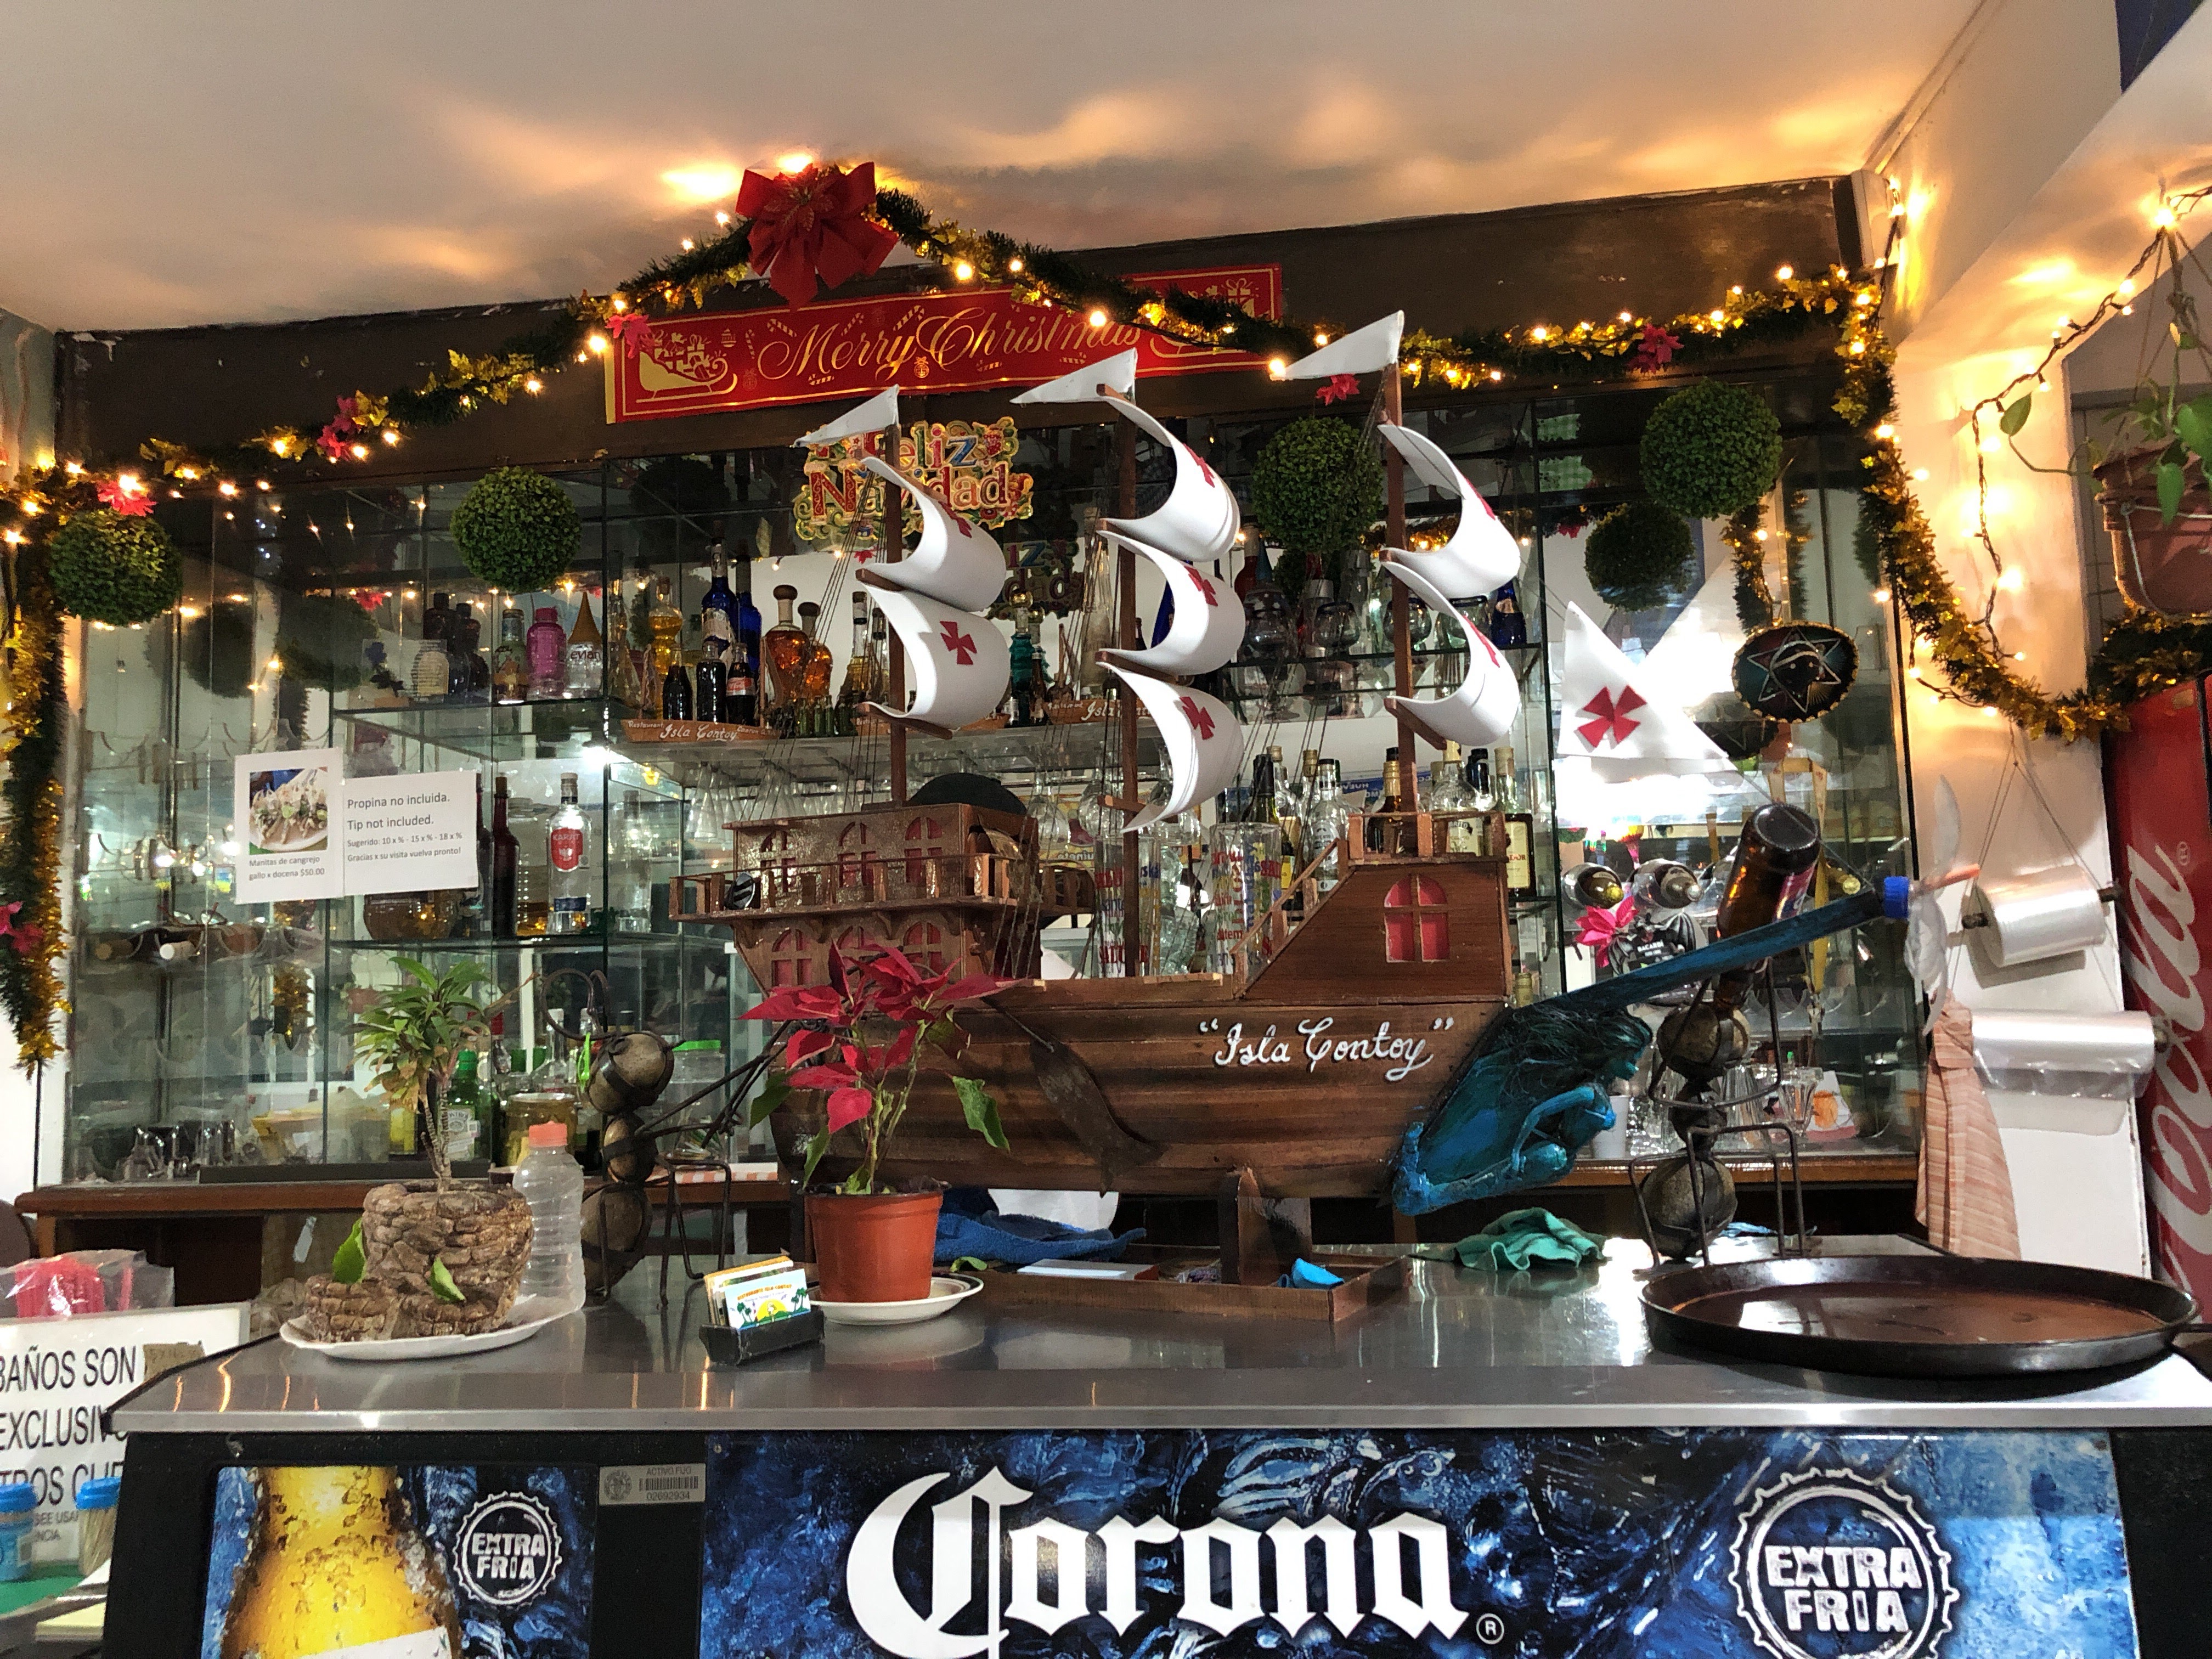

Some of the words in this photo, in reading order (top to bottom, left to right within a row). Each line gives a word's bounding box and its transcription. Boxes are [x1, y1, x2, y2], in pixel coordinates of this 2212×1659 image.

[758, 324, 917, 381] Merry
[916, 307, 1141, 371] Christmas
[660, 724, 690, 739] Isla
[697, 724, 737, 741] Contoy
[347, 797, 387, 810] Propina
[391, 798, 404, 806] no
[407, 792, 450, 805] incluida.
[348, 820, 363, 831] Tip
[366, 819, 383, 828] not
[387, 814, 434, 827] included.
[347, 838, 380, 848] Sugerido:
[434, 847, 461, 857] pronto!
[249, 858, 276, 866] Manitas
[289, 856, 320, 865] cangrejo
[301, 868, 325, 877] $50.00
[83, 1345, 136, 1387] SON
[472, 1532, 545, 1557] EXTRA
[477, 1555, 535, 1579] FRIA
[846, 1465, 1470, 1659] Corona
[1764, 1544, 1921, 1589] EXTRA
[1784, 1589, 1909, 1633] FRIA
